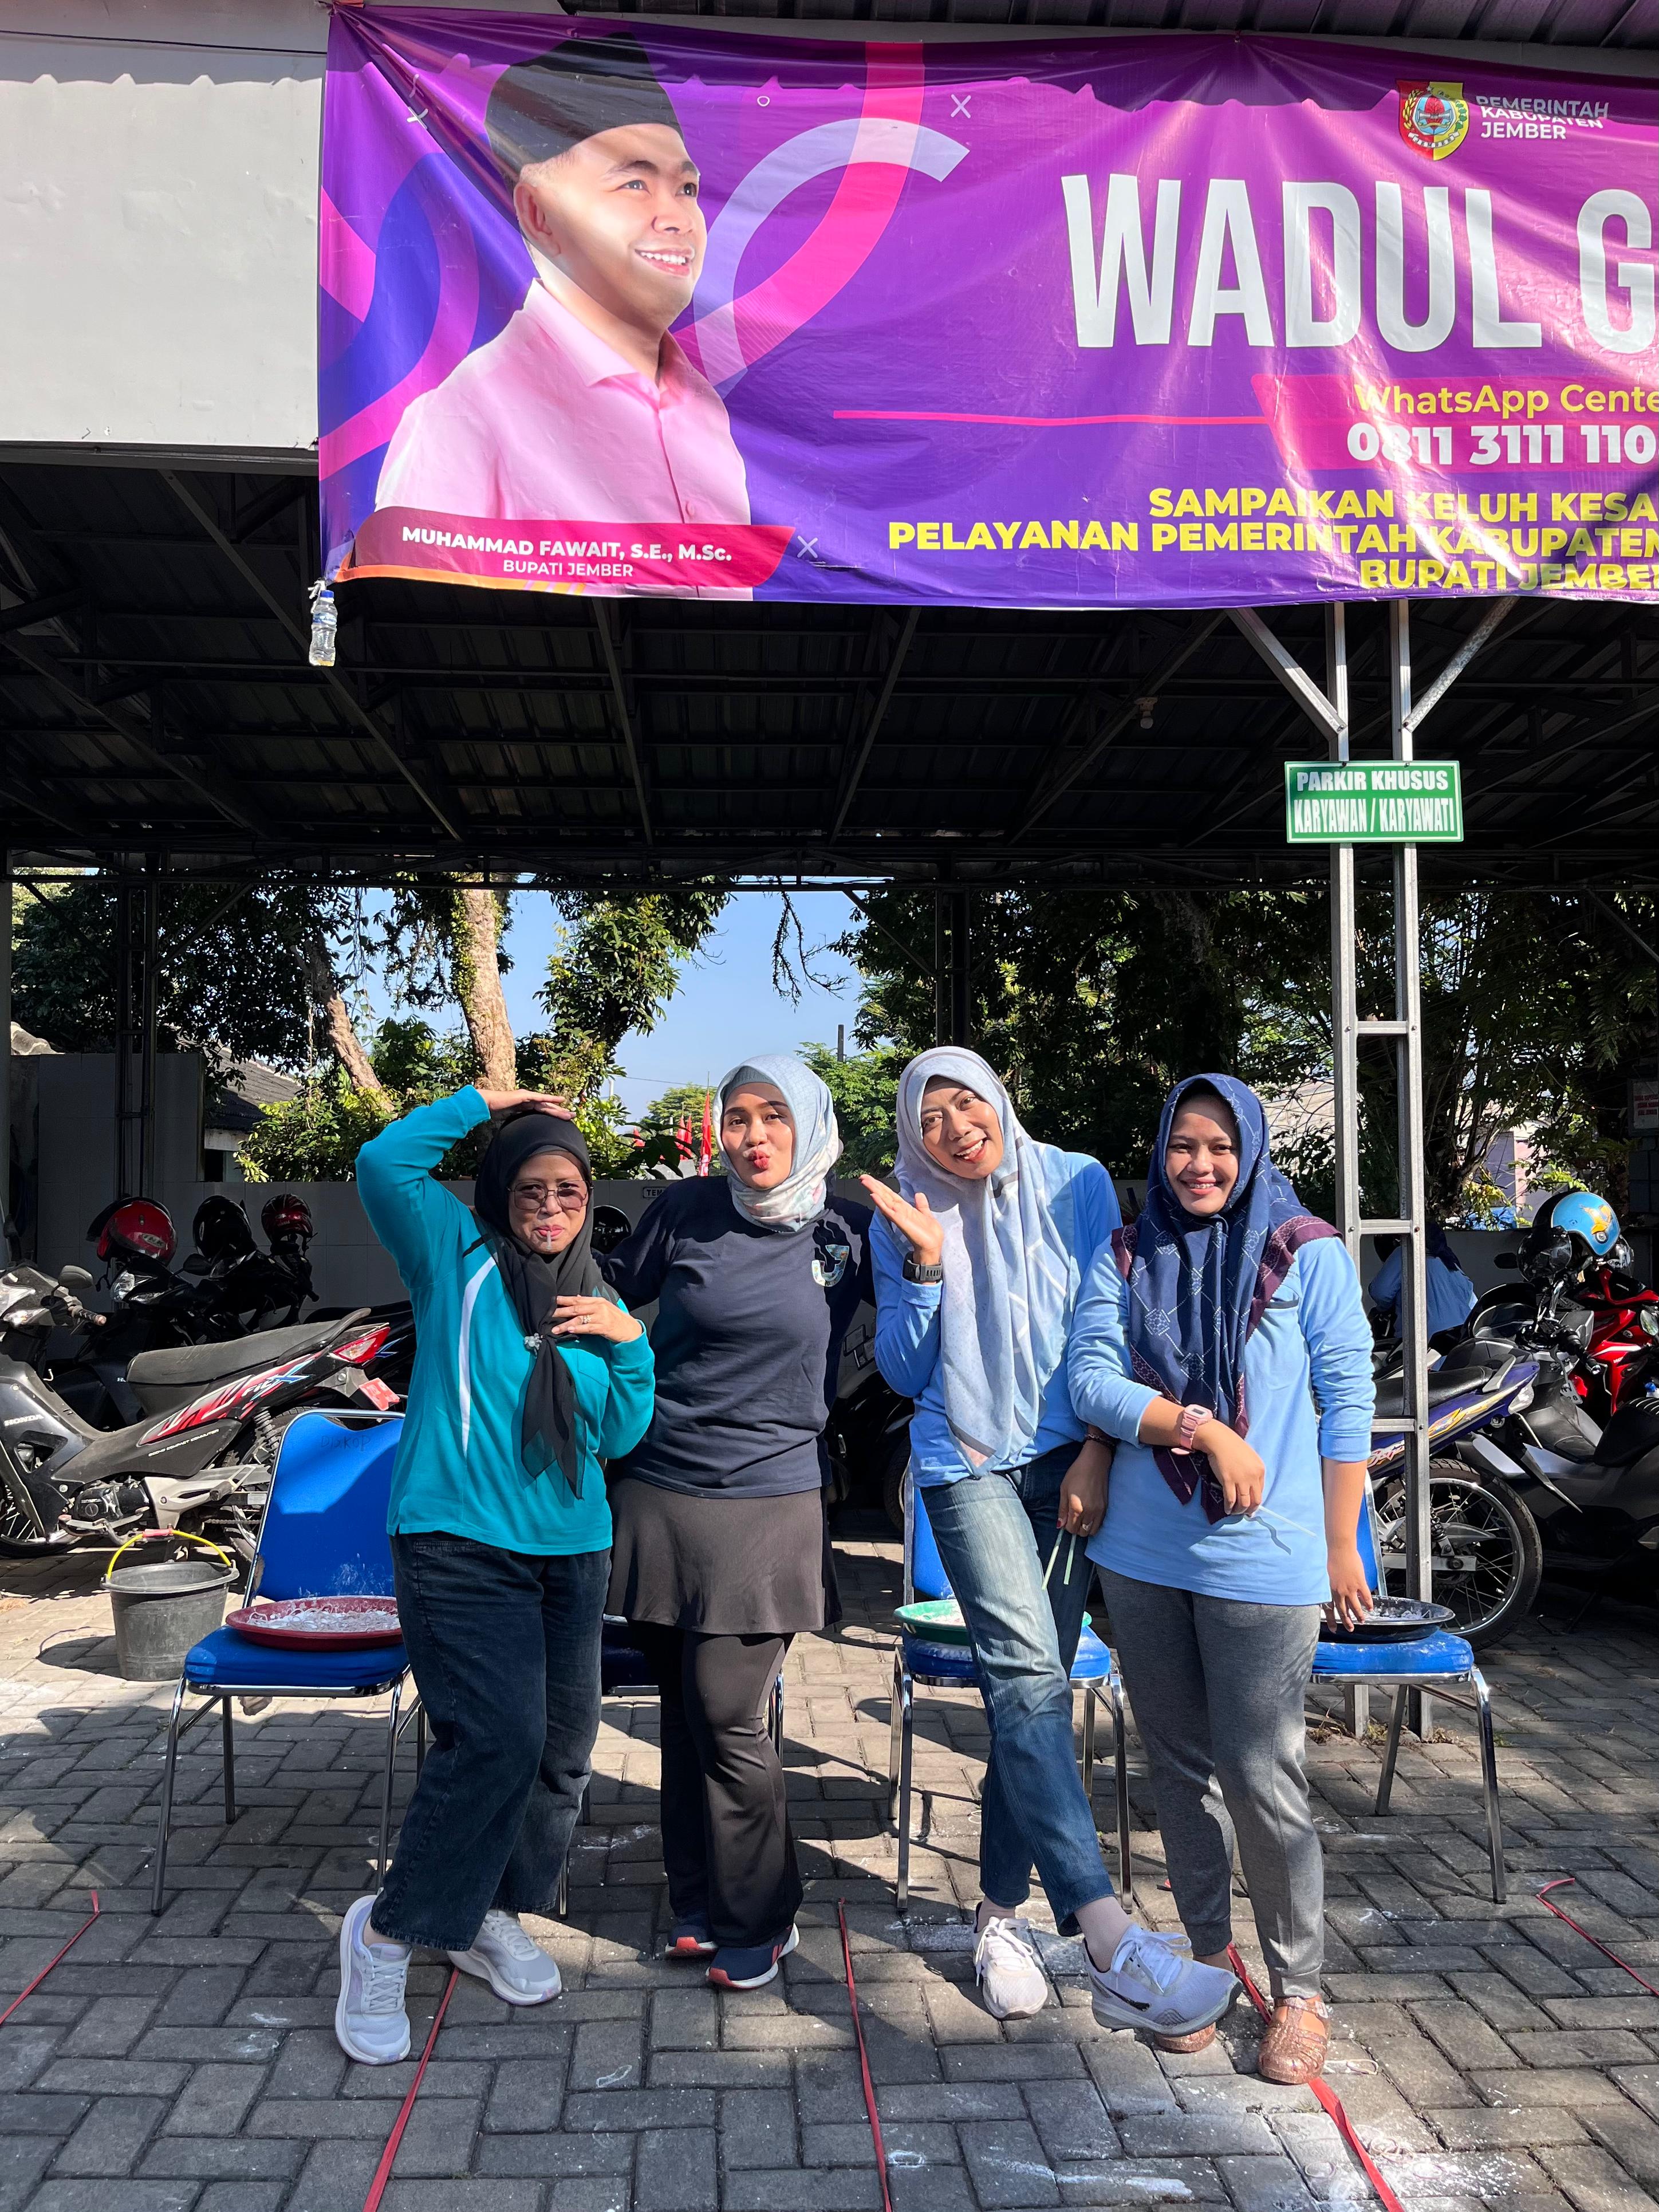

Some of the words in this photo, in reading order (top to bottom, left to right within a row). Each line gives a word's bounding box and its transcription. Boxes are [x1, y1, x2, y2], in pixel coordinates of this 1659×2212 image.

[1476, 96, 1609, 119] PEMERINTAH
[1480, 105, 1603, 129] KABUPATEN
[1481, 121, 1567, 139] JEMBER
[1061, 174, 1542, 352] WADUL
[1353, 384, 1549, 419] WhatsApp
[1347, 422, 1453, 465] 0811
[1469, 424, 1563, 465] 3111
[1149, 488, 1394, 518] SAMPAIKAN
[1405, 490, 1538, 522] KELUH
[403, 526, 534, 555] MUHAMMAD
[539, 540, 625, 561] FAWAIT,
[631, 543, 673, 563] S.E.,
[678, 543, 732, 561] M.Sc.
[889, 520, 1138, 551] PELAYANAN
[1152, 522, 1417, 554] PEMERINTAH
[503, 560, 563, 576] BUPATI
[567, 563, 634, 577] JEMBER
[1360, 559, 1507, 590] BUPATI
[1518, 563, 1659, 591] JEMBE
[1297, 771, 1367, 792] PARKIR
[1372, 770, 1449, 790] KHUSUS
[1294, 798, 1368, 833] KARYAWAN
[1378, 797, 1455, 832] KARYAWATI
[3, 1414, 44, 1426] HONDA
